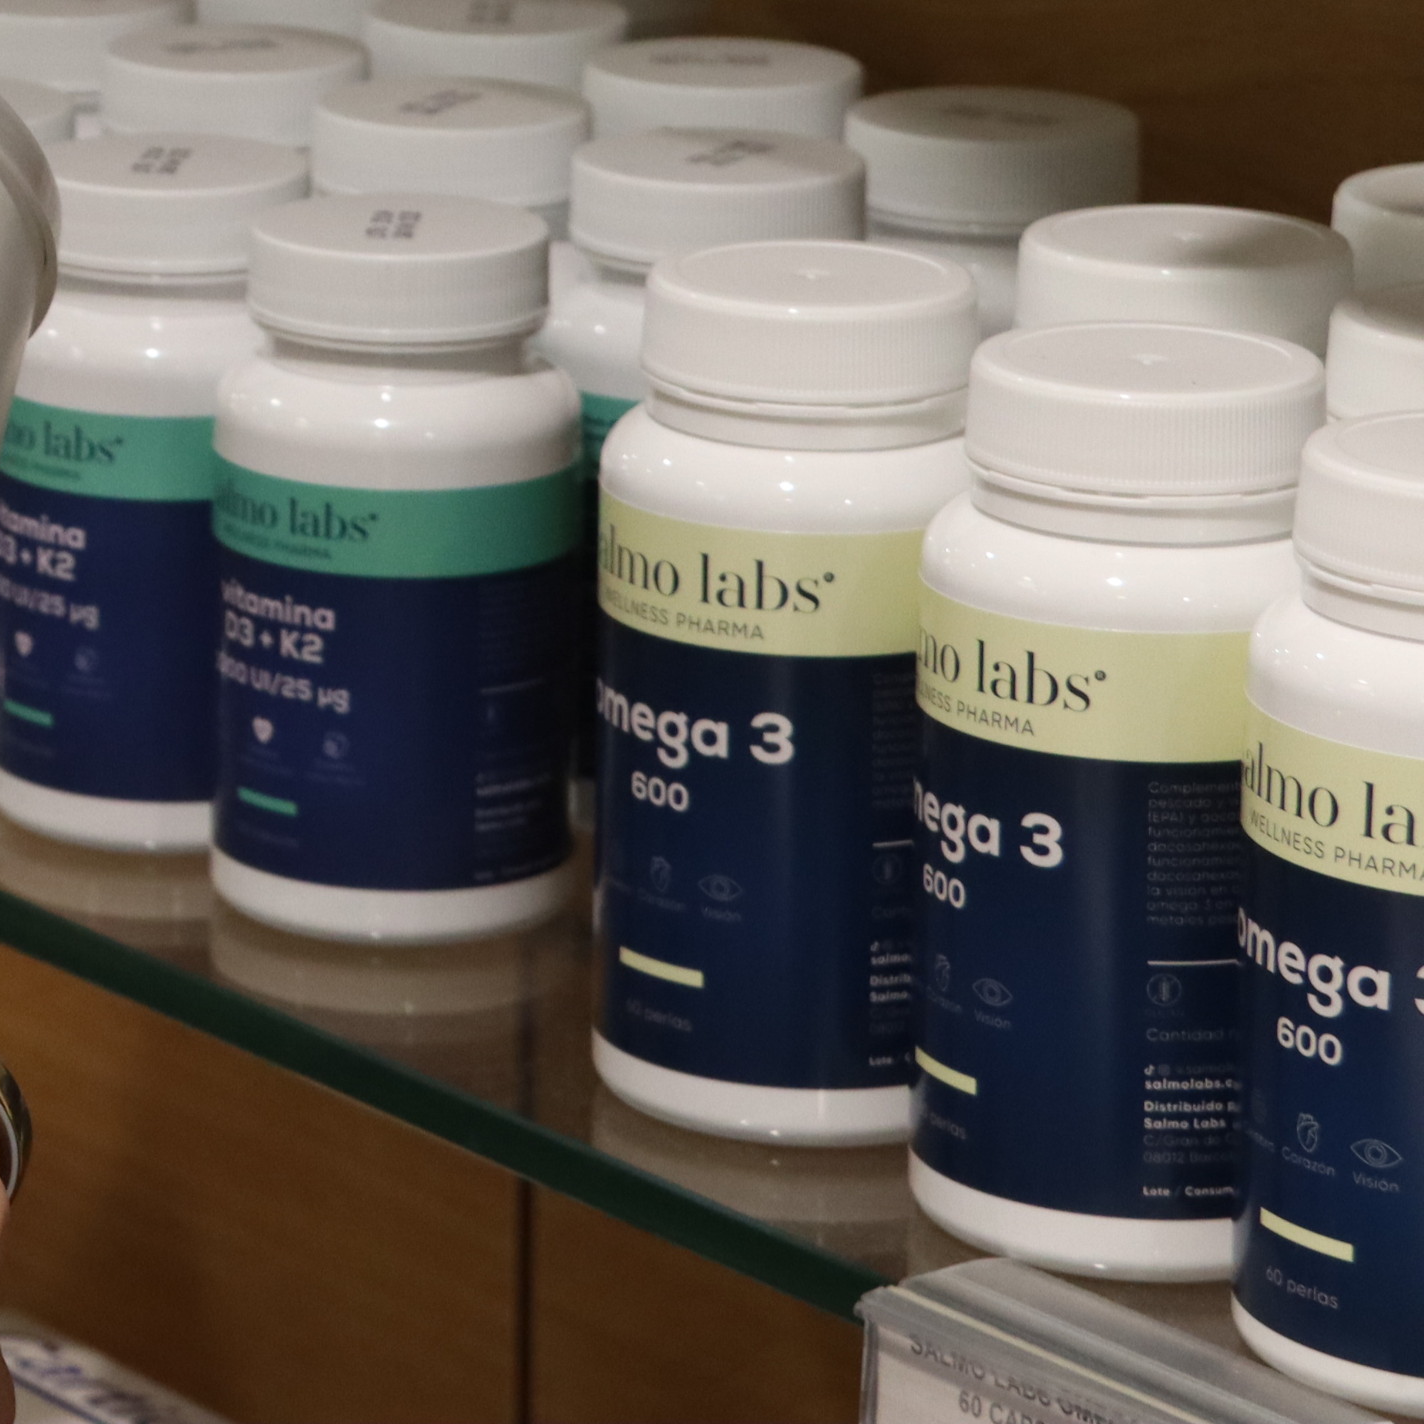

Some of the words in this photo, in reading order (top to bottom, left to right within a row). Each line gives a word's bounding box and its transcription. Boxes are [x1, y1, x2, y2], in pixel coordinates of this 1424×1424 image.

[36, 546, 76, 582] K2
[221, 577, 336, 631] vitamina
[677, 612, 764, 641] PHARMA
[225, 609, 255, 648] D3
[280, 628, 325, 664] K2
[749, 711, 795, 765] 3
[957, 700, 1034, 737] PHARMA
[630, 770, 690, 813] 600
[1020, 811, 1064, 869] 3
[1251, 810, 1325, 859] WELLNESS
[923, 862, 966, 910] 600
[1238, 906, 1390, 1019] omega
[1277, 1016, 1344, 1067] 600
[1144, 1100, 1223, 1113] Distribuido
[1144, 1117, 1189, 1130] Salmo
[1193, 1118, 1226, 1129] Labs
[1142, 1186, 1170, 1198] Lote
[1266, 1265, 1283, 1287] 60
[1287, 1278, 1339, 1310] perlas
[959, 1390, 983, 1418] 60
